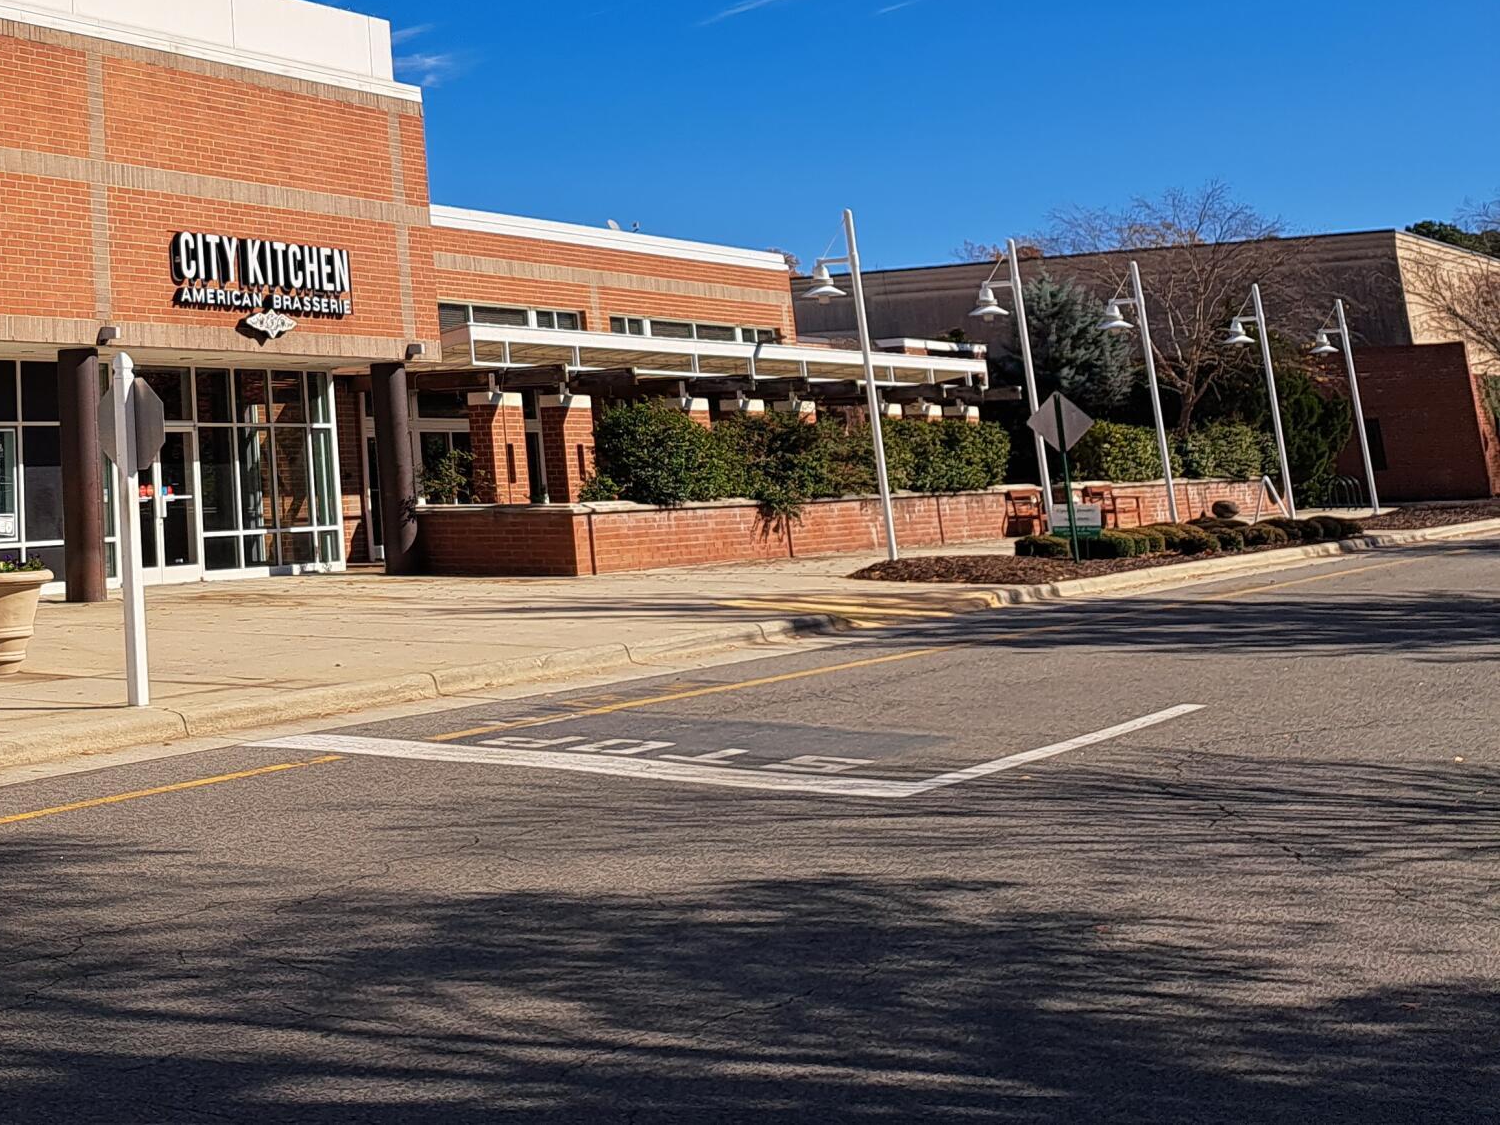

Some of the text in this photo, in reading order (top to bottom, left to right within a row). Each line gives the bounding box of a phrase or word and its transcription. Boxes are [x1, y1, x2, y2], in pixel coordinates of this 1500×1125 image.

[180, 231, 350, 292] CITY KITCHEN
[181, 286, 351, 315] AMERICAN BRASSERIE
